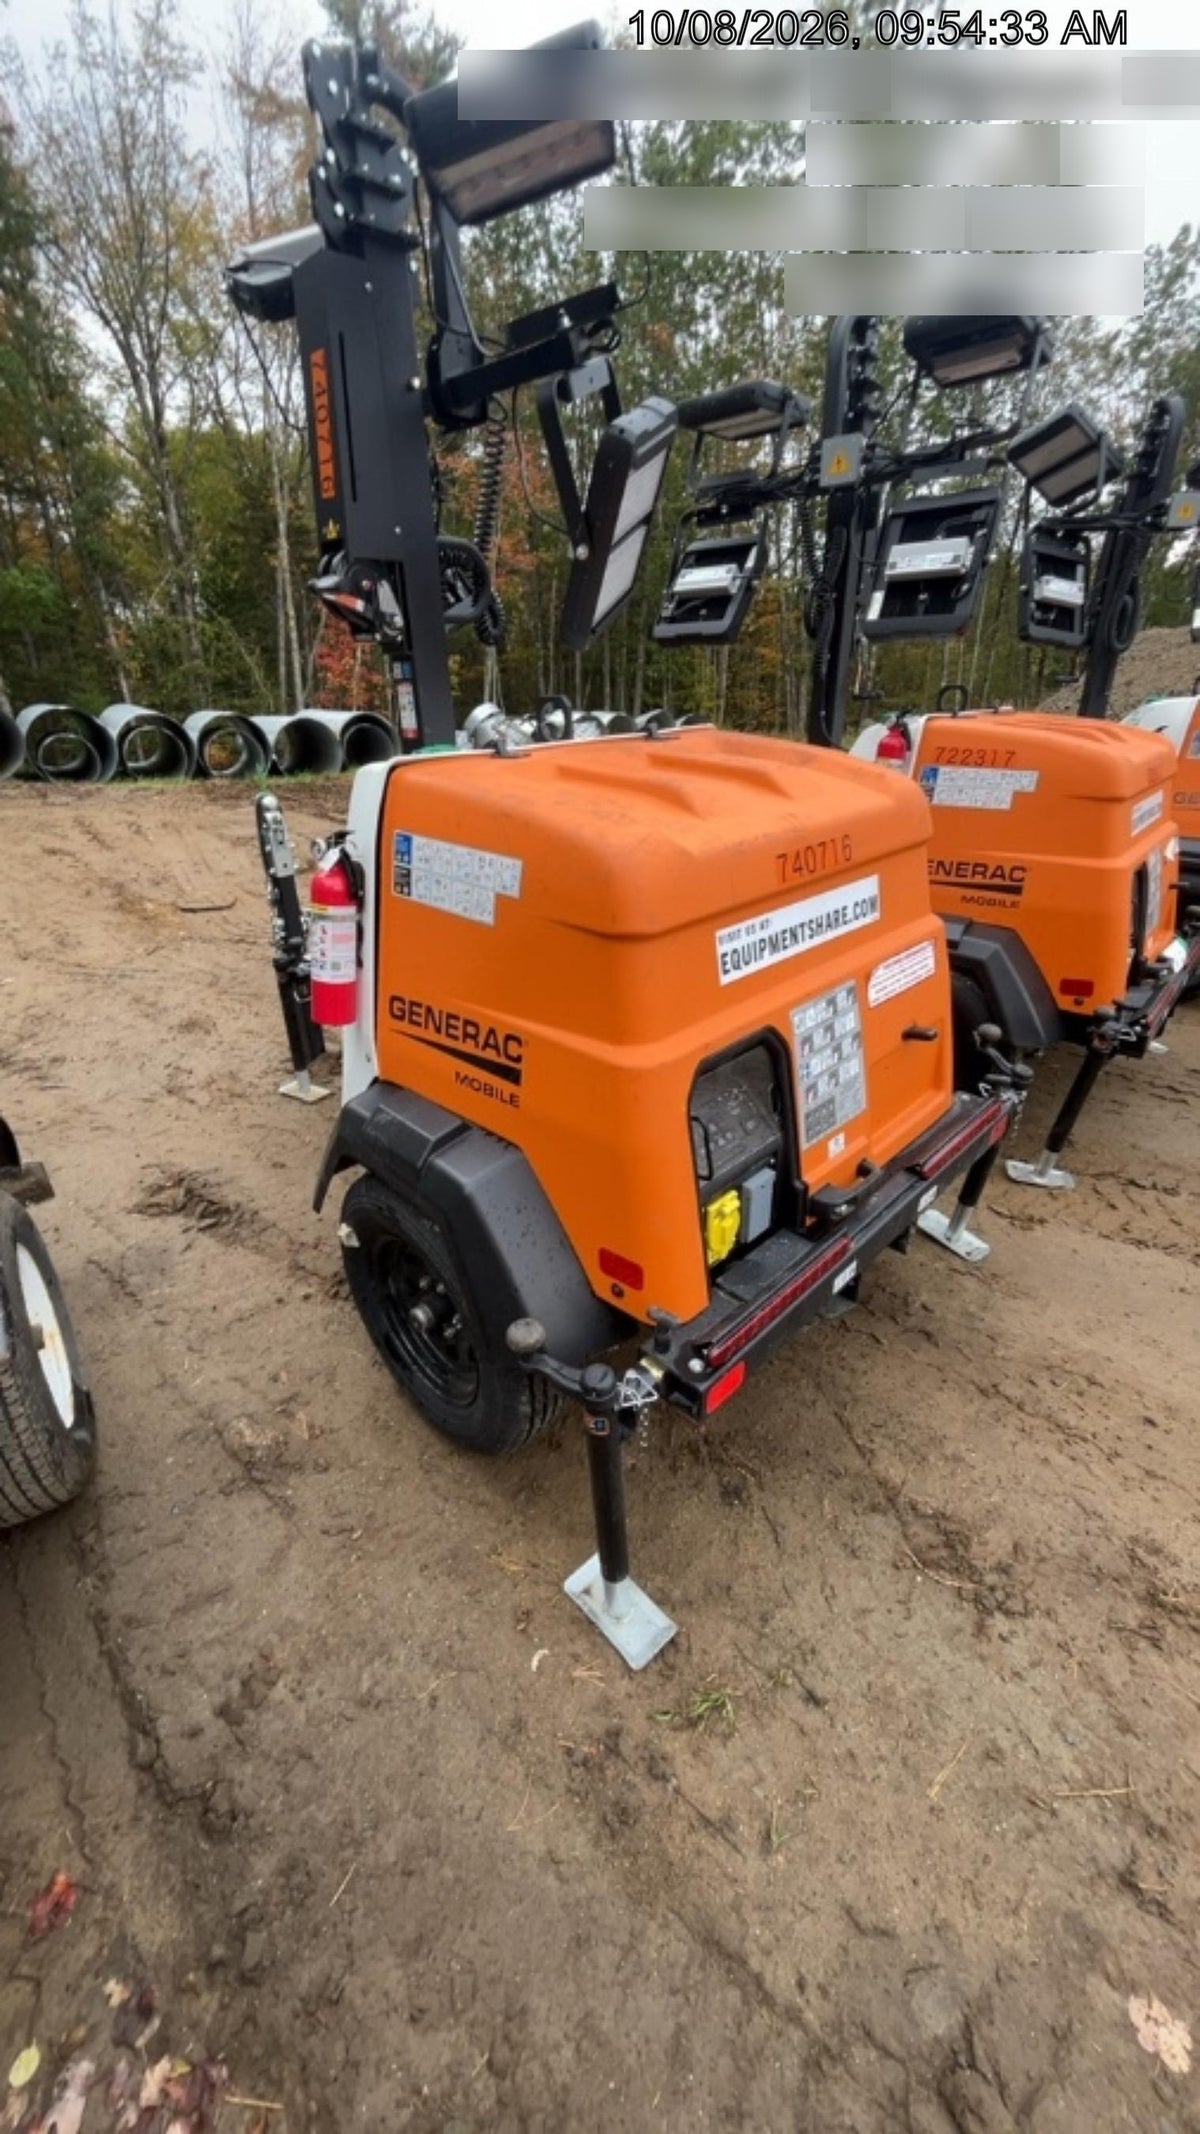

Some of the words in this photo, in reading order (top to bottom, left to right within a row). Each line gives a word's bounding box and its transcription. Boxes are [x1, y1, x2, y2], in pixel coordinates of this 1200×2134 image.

[936, 747, 1016, 767] 722317
[776, 834, 852, 884] 740716
[928, 860, 1027, 883] ENERAC
[720, 894, 879, 975] EQUIPMENTSHARE.COM
[389, 995, 523, 1064] GENERAC
[455, 1071, 520, 1109] MOBILE
